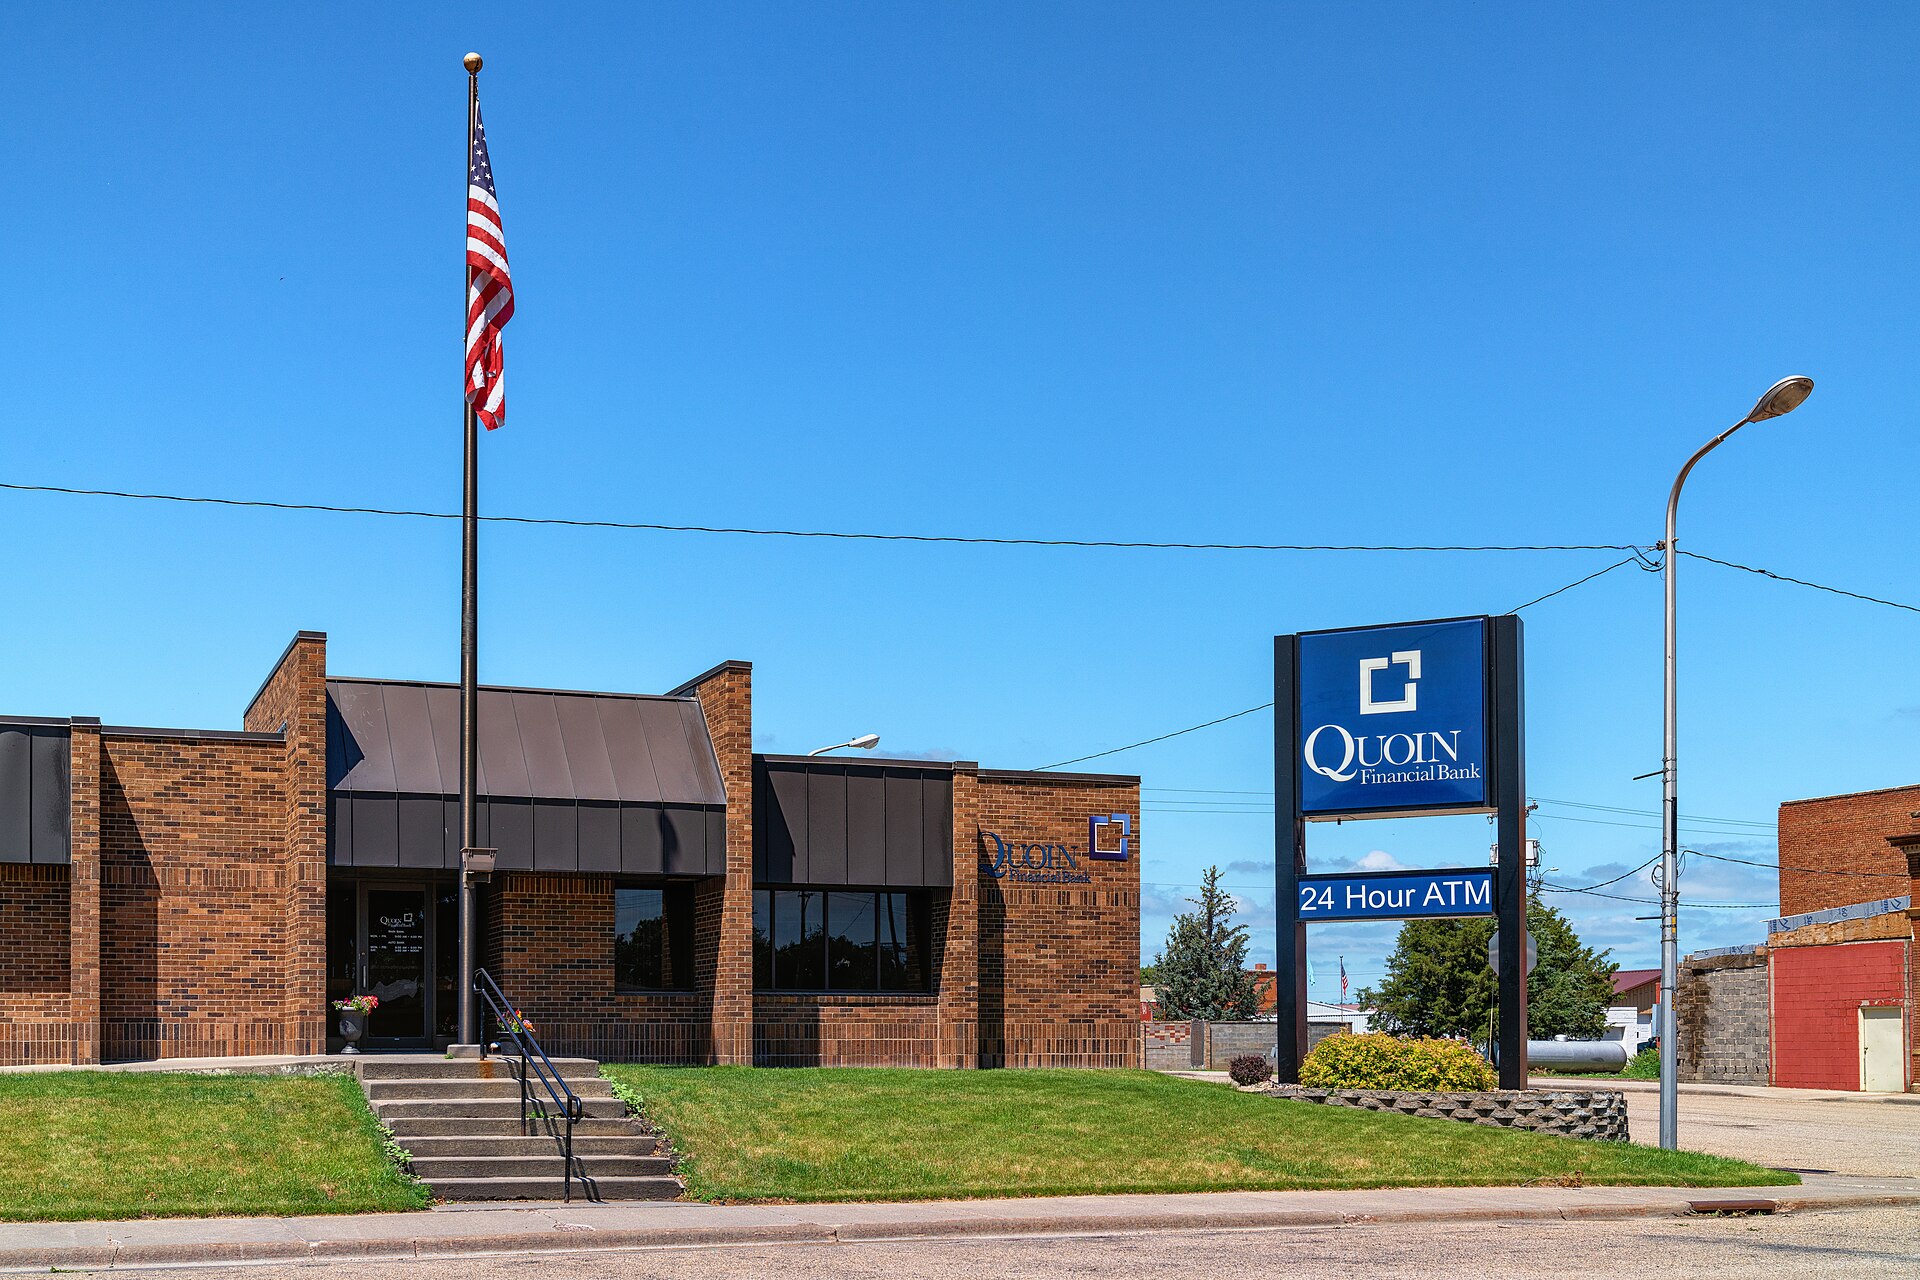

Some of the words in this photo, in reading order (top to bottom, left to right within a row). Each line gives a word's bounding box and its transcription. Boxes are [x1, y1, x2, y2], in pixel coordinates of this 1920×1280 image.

[1304, 724, 1461, 782] QUOIN
[1360, 766, 1434, 784] Financial
[1438, 763, 1481, 780] Bank
[978, 831, 1078, 878] QUOIN
[1009, 868, 1060, 883] Financial
[1062, 871, 1091, 883] Bank
[1300, 886, 1335, 911] 24
[1346, 884, 1416, 909] Hour
[1422, 879, 1490, 907] ATM
